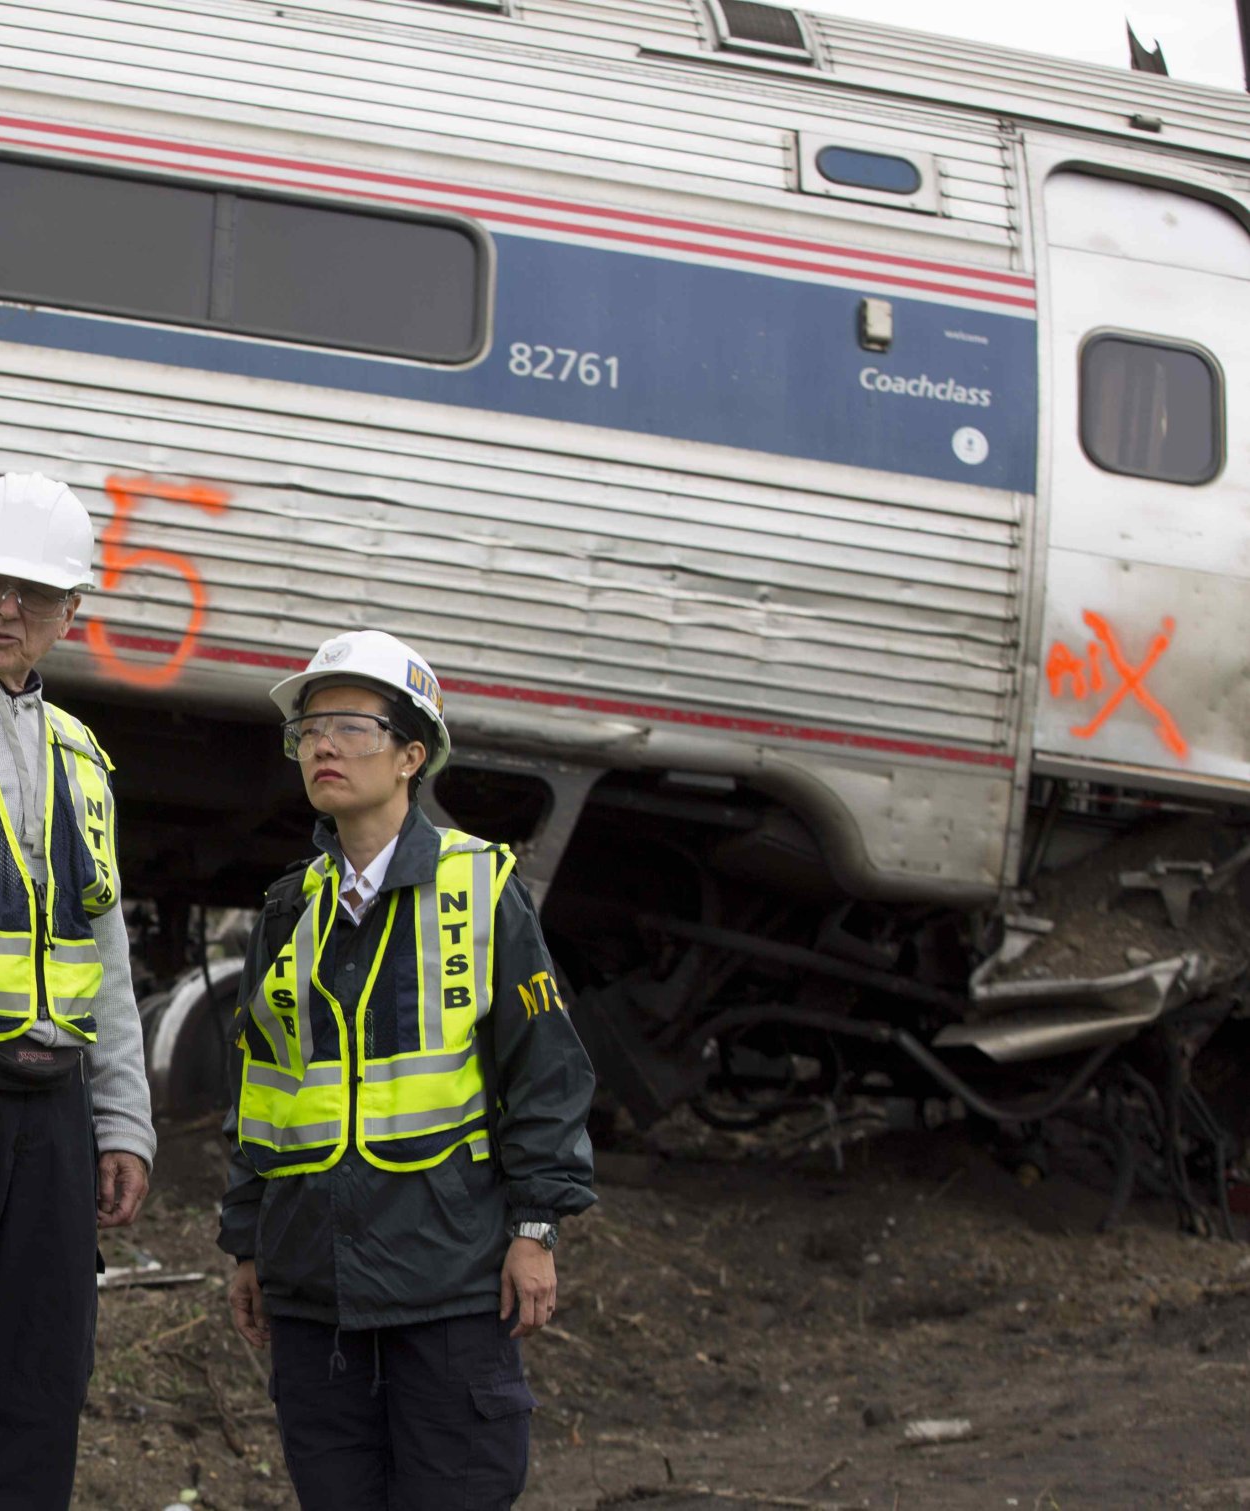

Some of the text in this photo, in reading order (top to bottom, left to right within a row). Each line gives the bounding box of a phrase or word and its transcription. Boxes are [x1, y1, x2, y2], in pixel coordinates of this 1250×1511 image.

[508, 341, 620, 389] 82761
[858, 366, 993, 408] Coachclass
[86, 475, 234, 688] 5
[439, 890, 472, 1010] NTSB
[271, 955, 297, 1040] TSB
